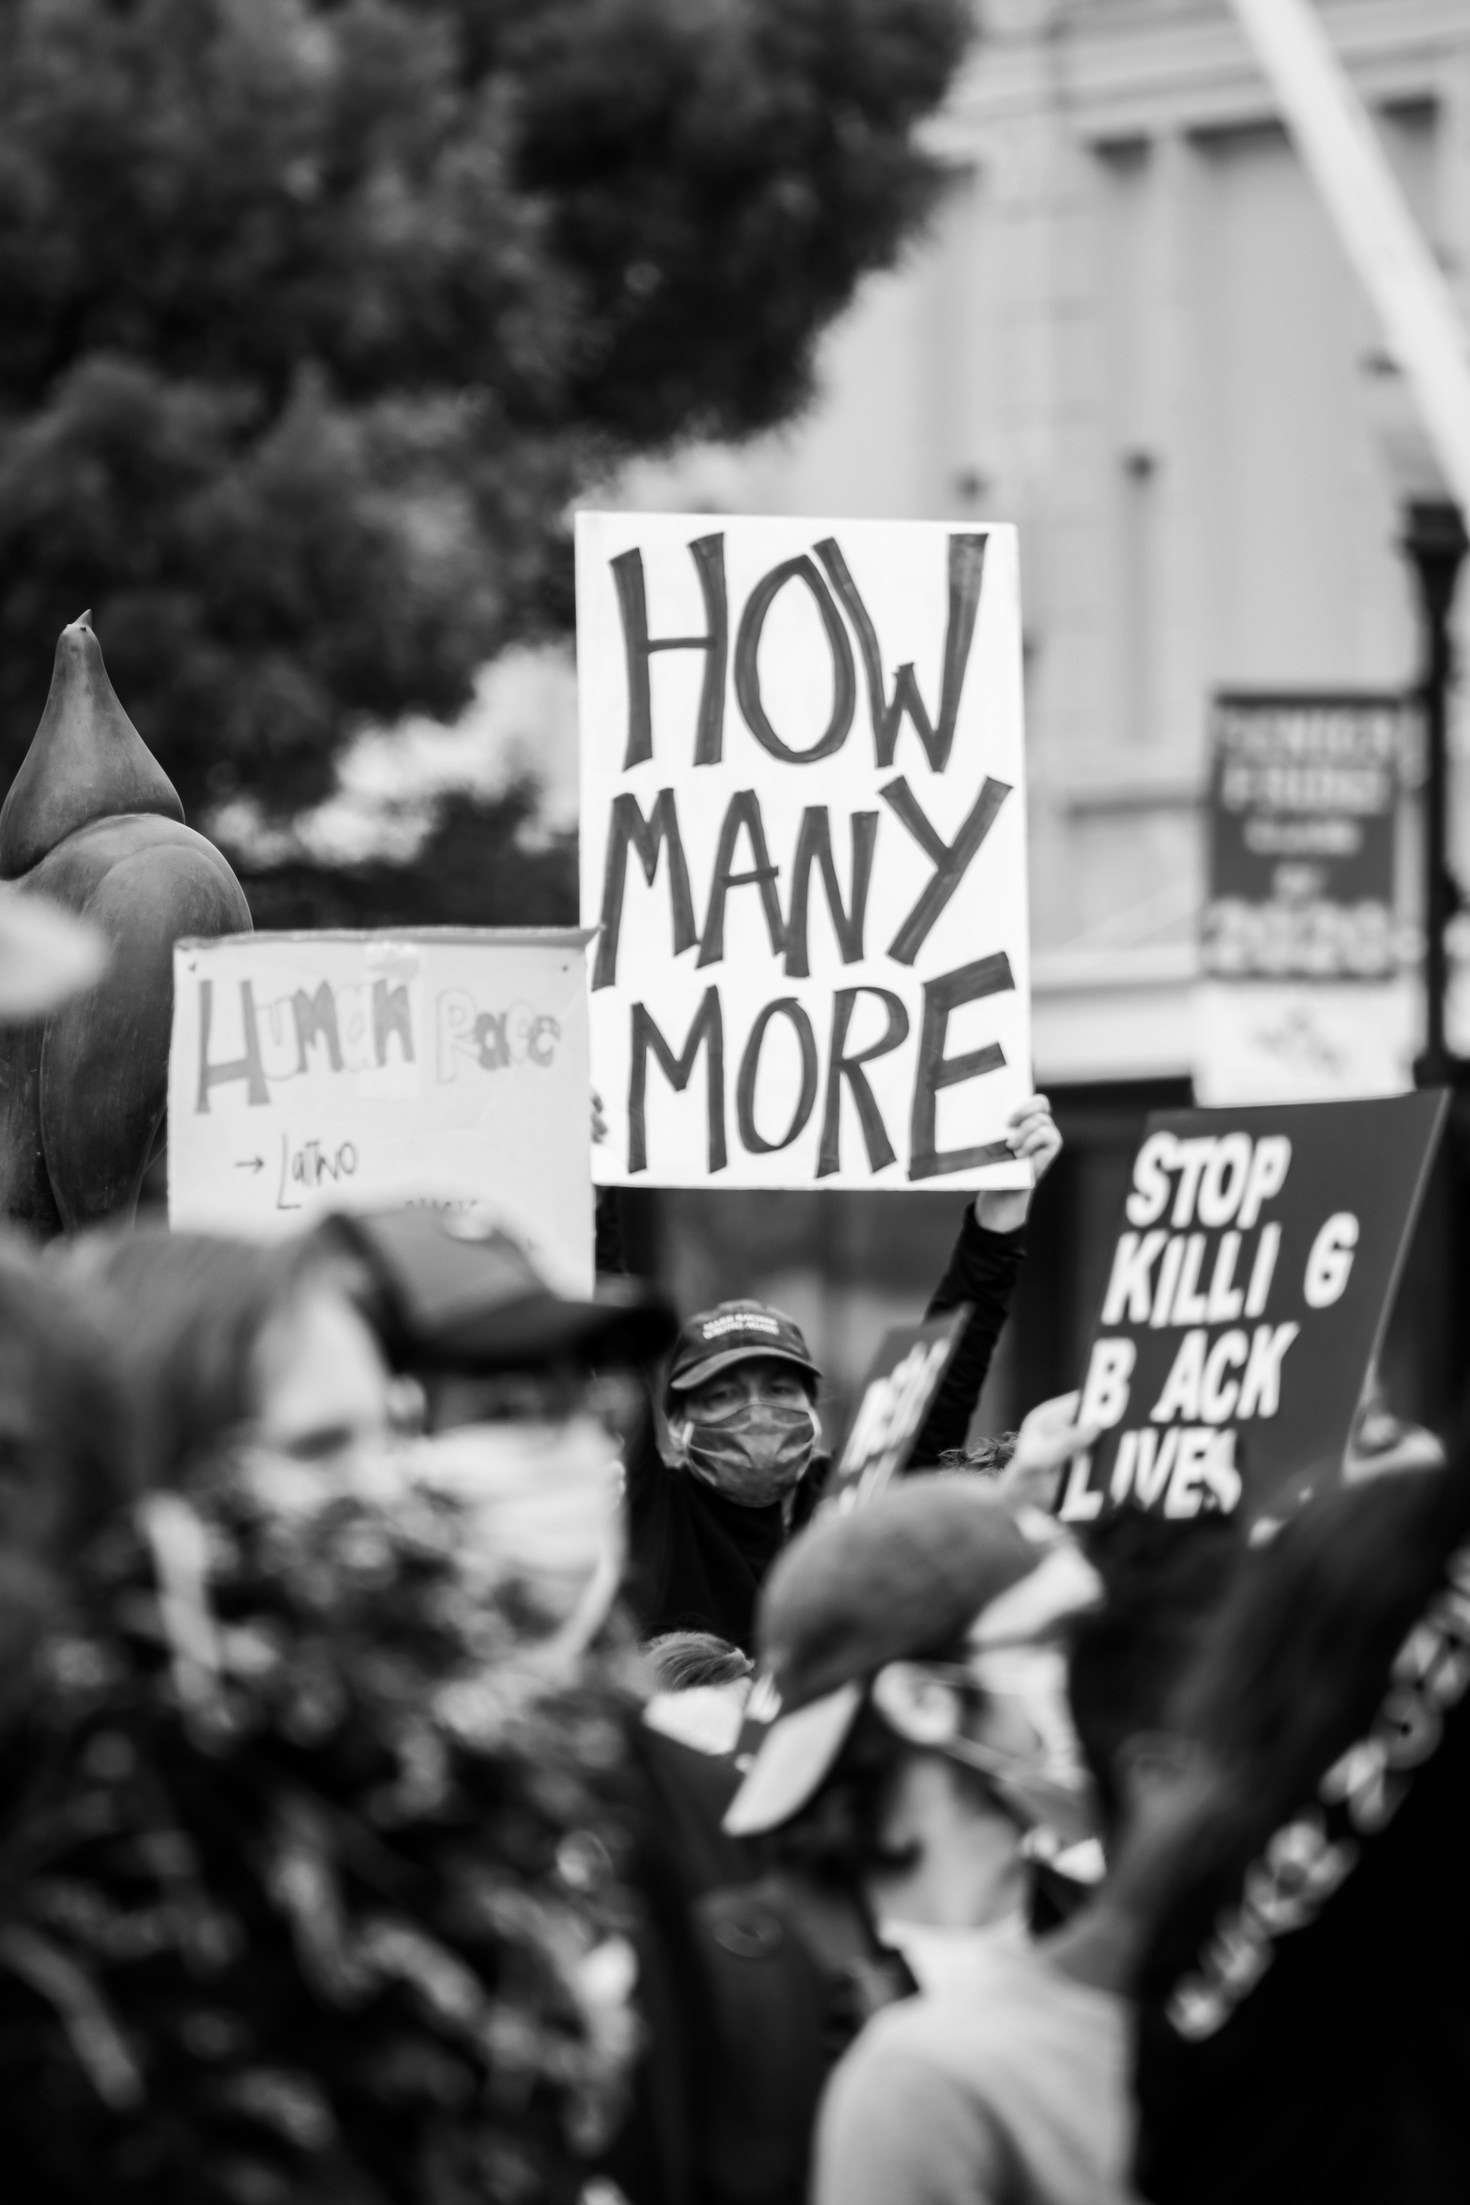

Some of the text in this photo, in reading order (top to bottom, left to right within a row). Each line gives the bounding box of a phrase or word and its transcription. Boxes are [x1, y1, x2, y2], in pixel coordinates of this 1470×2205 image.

[609, 532, 989, 773] HOW
[591, 775, 1014, 992] MANY
[626, 951, 1016, 1182] MORE
[1126, 1130, 1292, 1229] STOP
